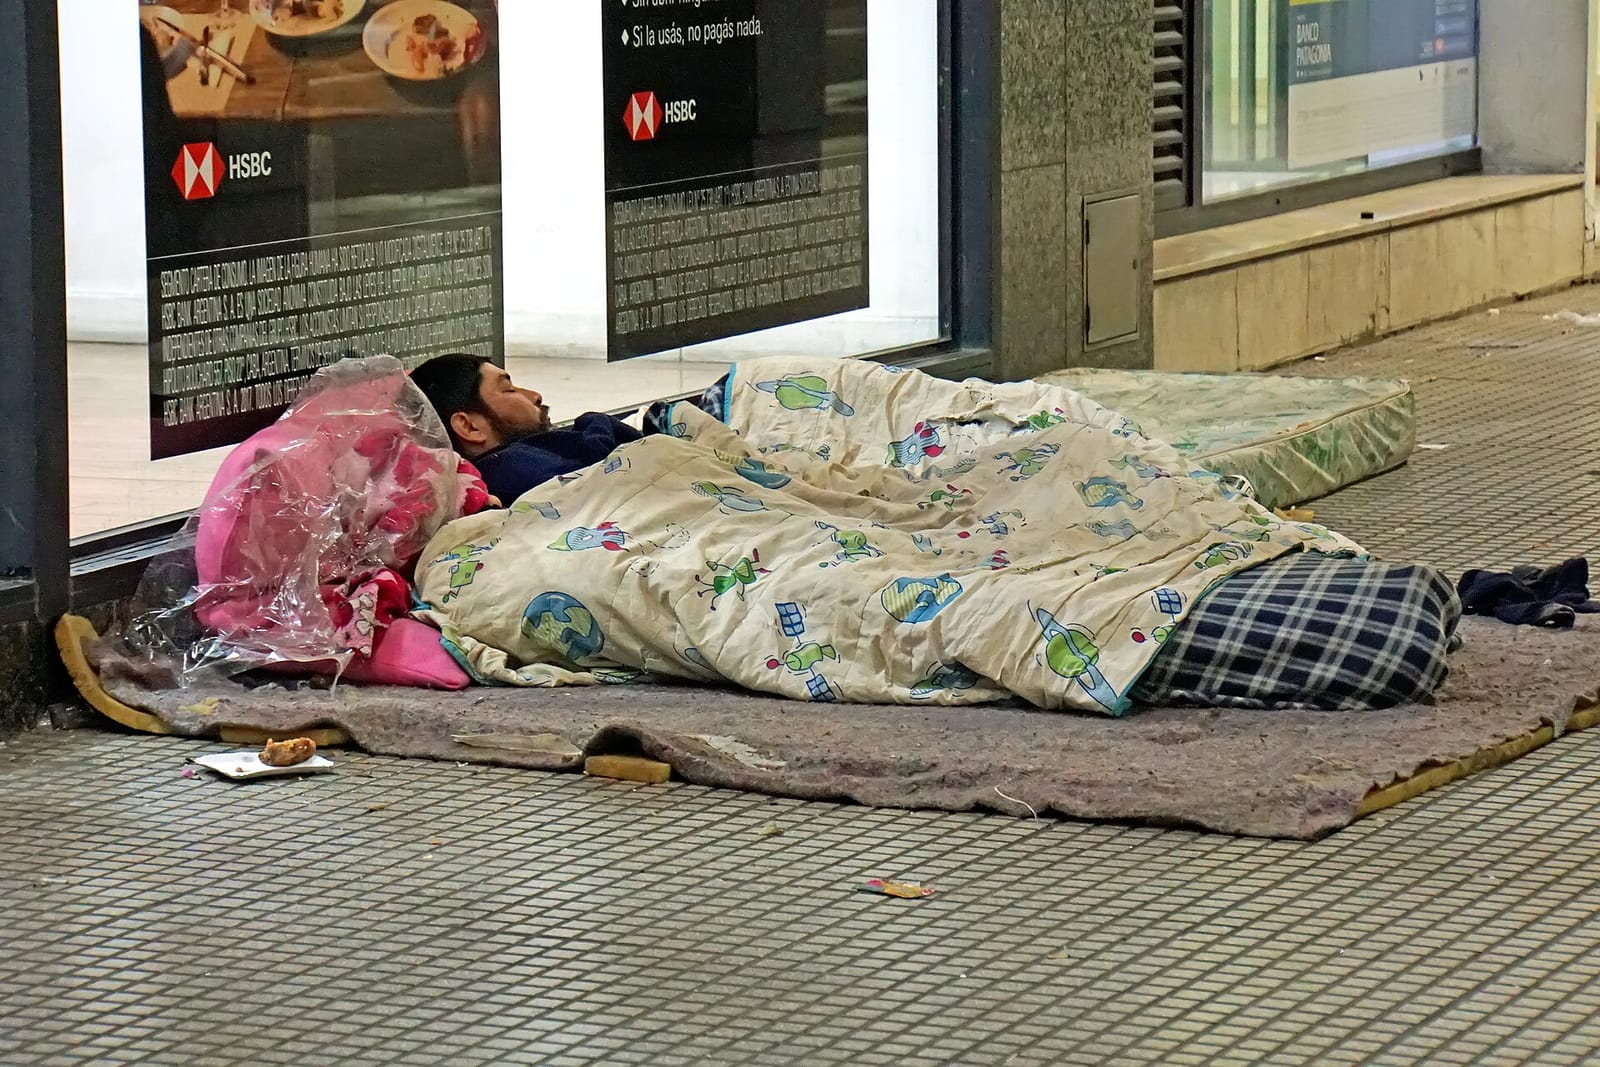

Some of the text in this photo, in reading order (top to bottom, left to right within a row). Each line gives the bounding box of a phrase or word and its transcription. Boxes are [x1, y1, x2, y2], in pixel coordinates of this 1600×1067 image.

[632, 15, 764, 48] Si la usás, no pagás nada.
[1296, 22, 1319, 44] BANCO
[1296, 43, 1332, 66] PATAGONIA
[664, 99, 697, 124] HSBC
[229, 151, 272, 180] HSBC
